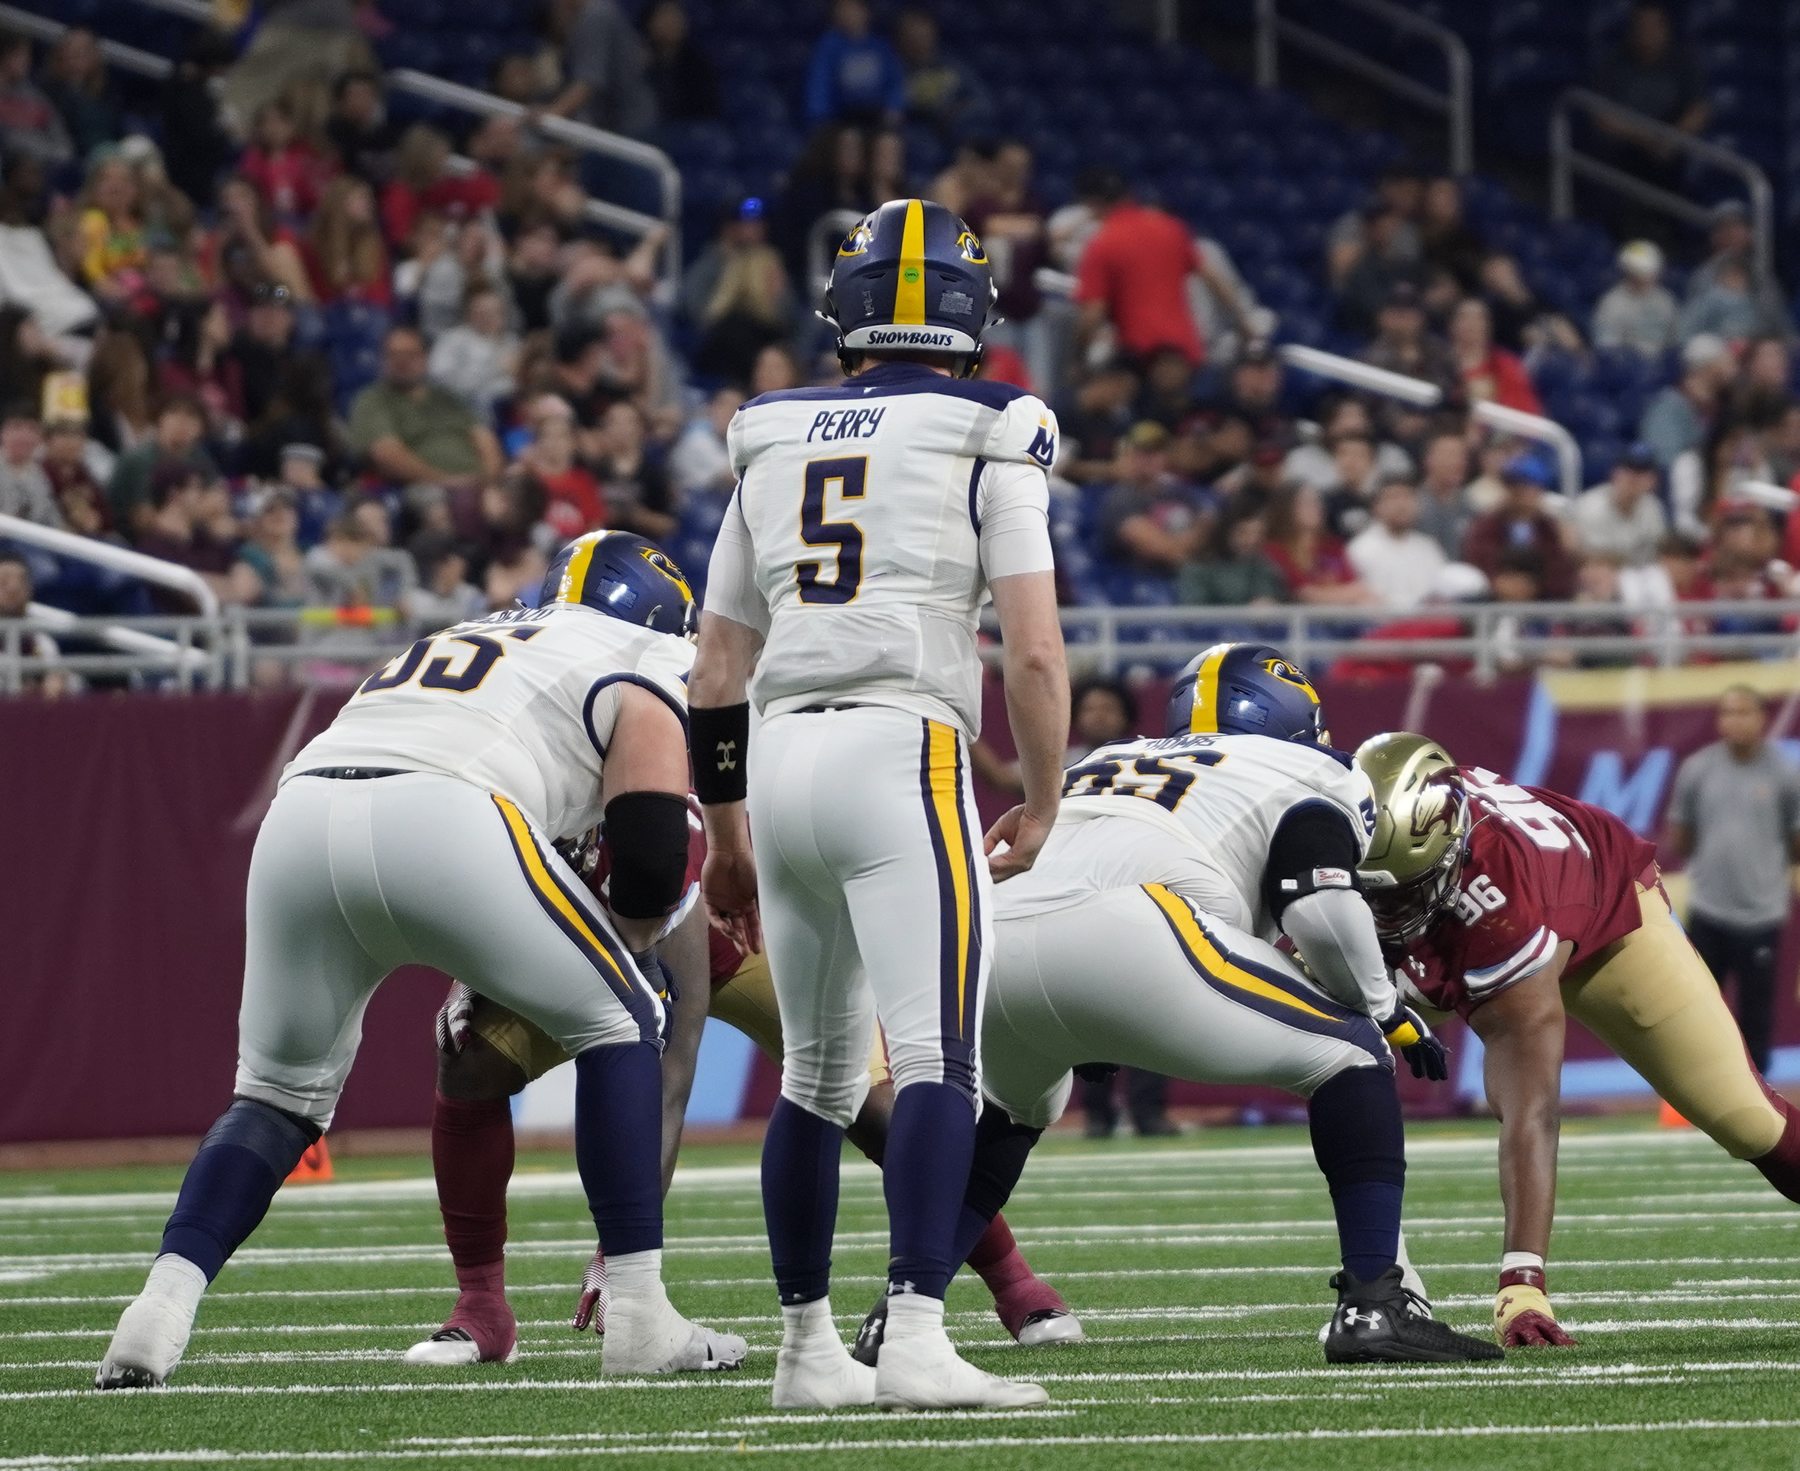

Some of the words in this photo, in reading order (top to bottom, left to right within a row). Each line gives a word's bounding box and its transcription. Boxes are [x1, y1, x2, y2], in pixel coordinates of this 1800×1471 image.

[867, 330, 954, 346] SHOWBOATS
[807, 406, 887, 443] PERRY
[795, 454, 869, 605] 5
[1454, 873, 1507, 927] 96
